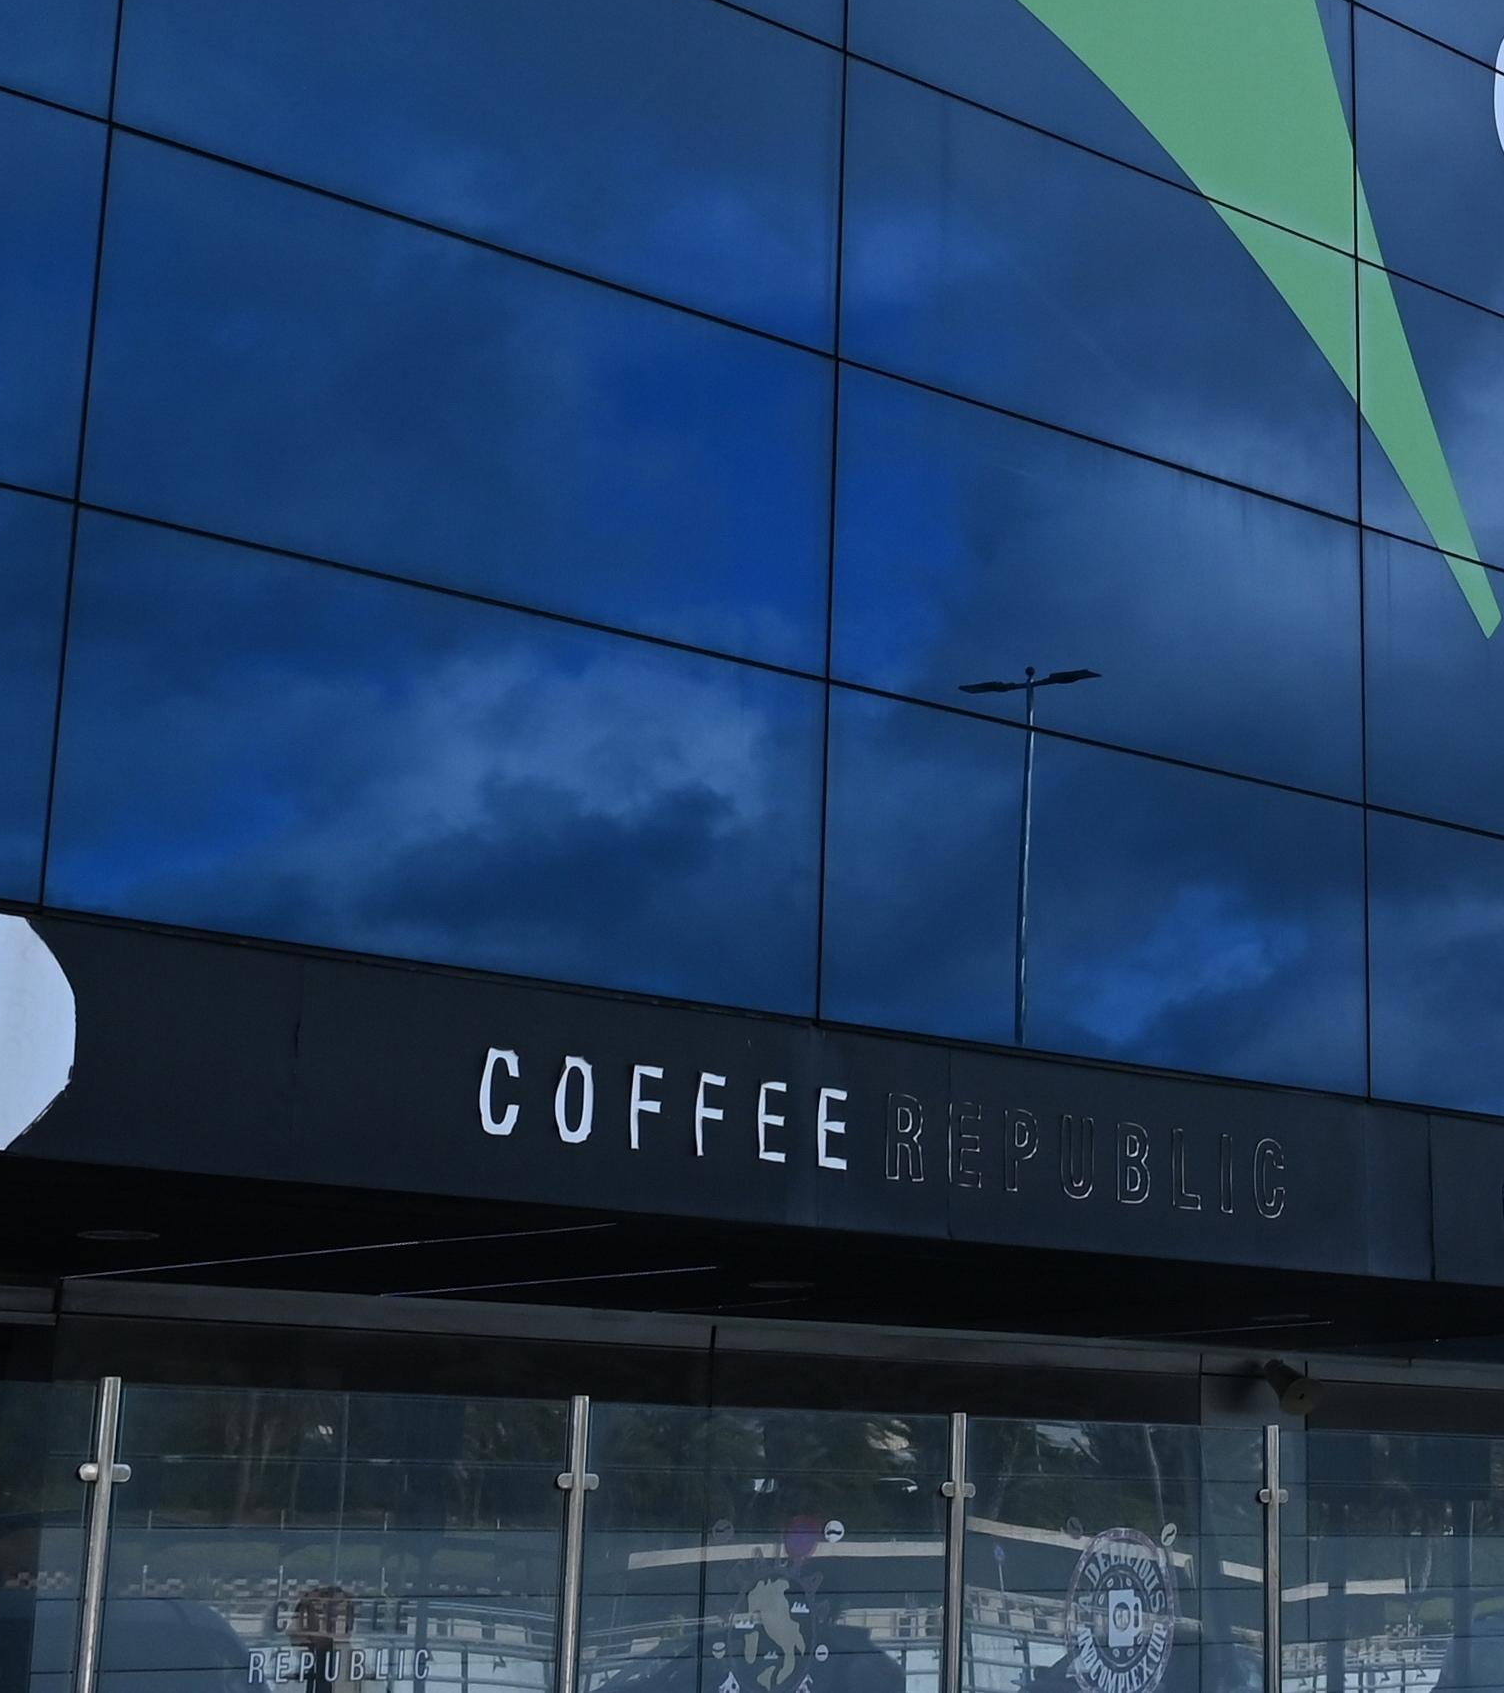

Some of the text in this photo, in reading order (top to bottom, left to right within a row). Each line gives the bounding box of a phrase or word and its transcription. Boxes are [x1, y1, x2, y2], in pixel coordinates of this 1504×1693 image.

[478, 1046, 1287, 1219] COFFEE REPUBLIC
[1084, 1542, 1166, 1614] DELICIOUS
[248, 1648, 431, 1685] REPUBLIC
[1077, 1622, 1097, 1669] AND
[1147, 1622, 1169, 1663] CUP
